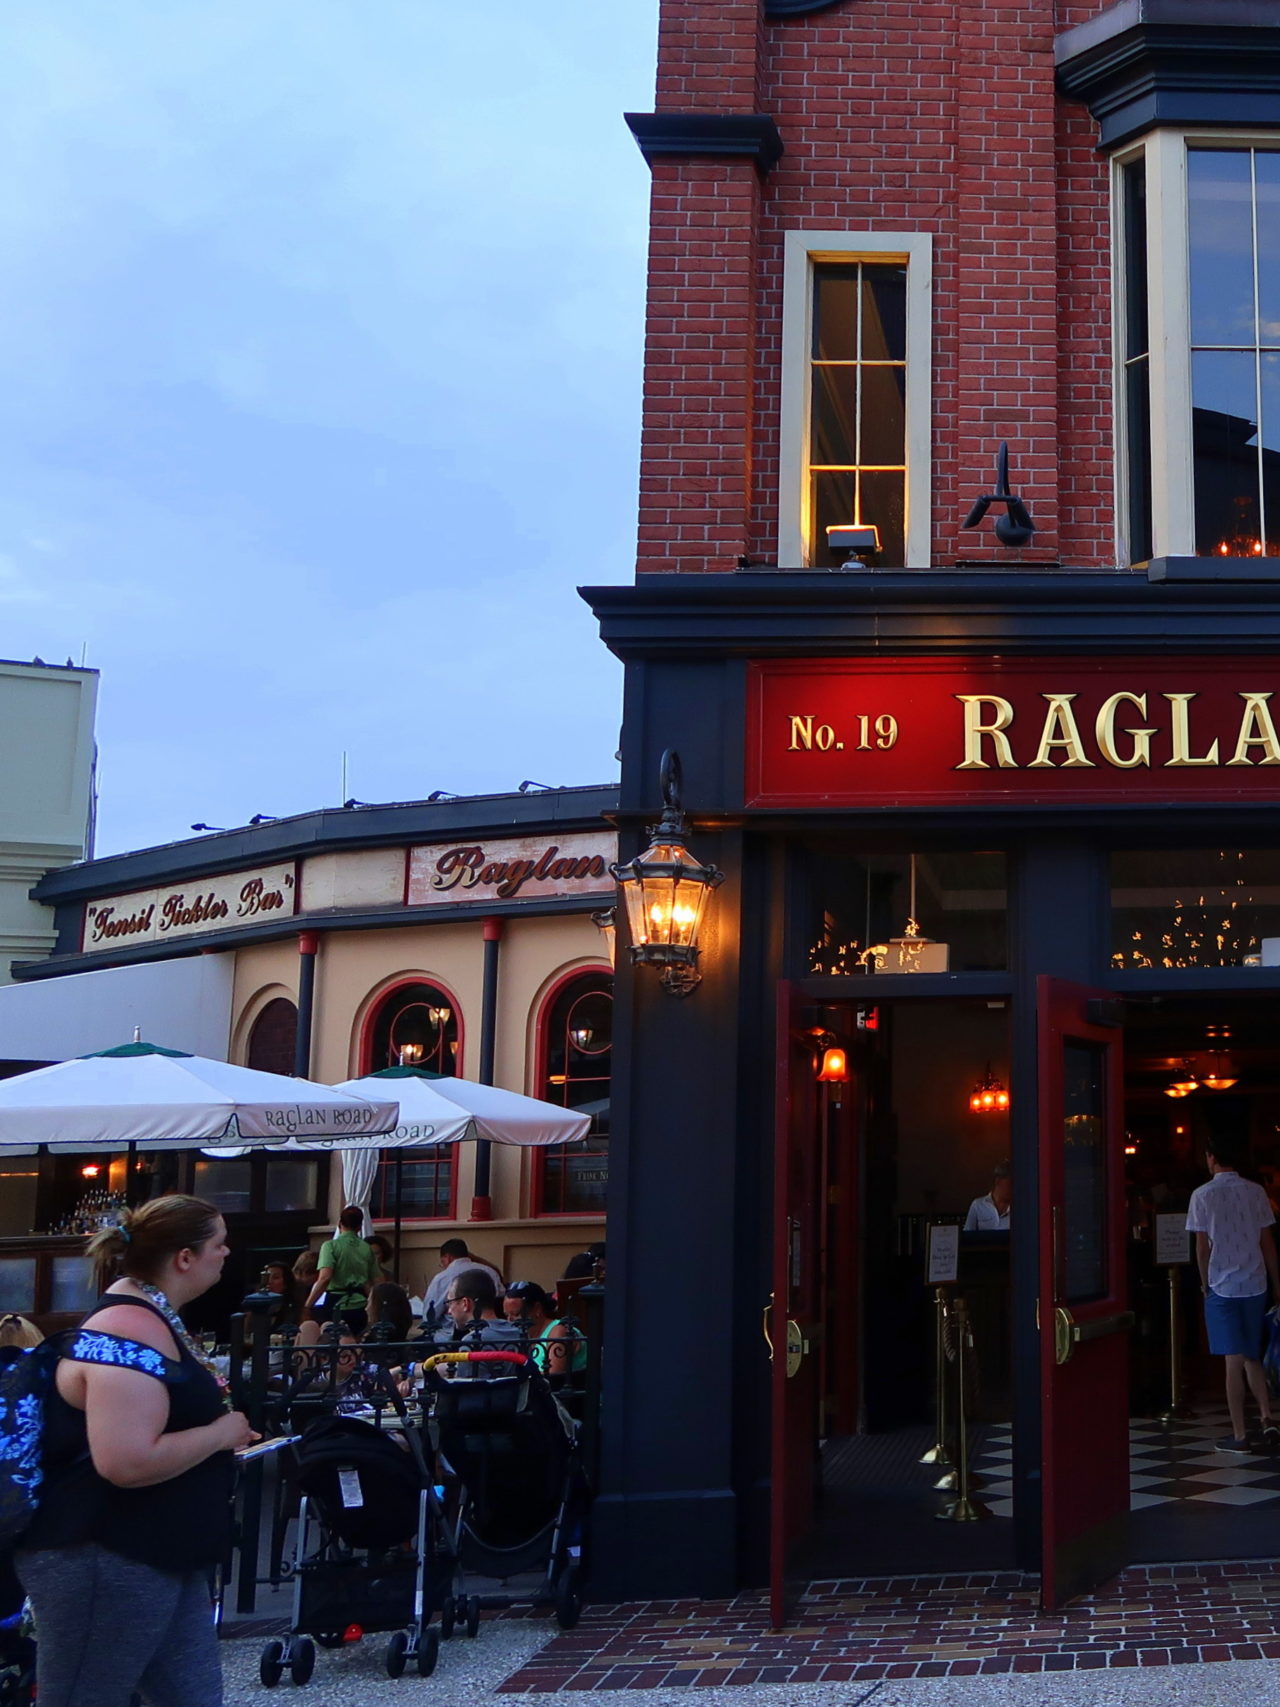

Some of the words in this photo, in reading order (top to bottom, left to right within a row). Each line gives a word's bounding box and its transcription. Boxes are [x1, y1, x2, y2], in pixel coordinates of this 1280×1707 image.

[787, 714, 844, 751] No.
[855, 714, 898, 750] 19
[429, 843, 606, 898] Raglan
[158, 893, 229, 931] Tickler
